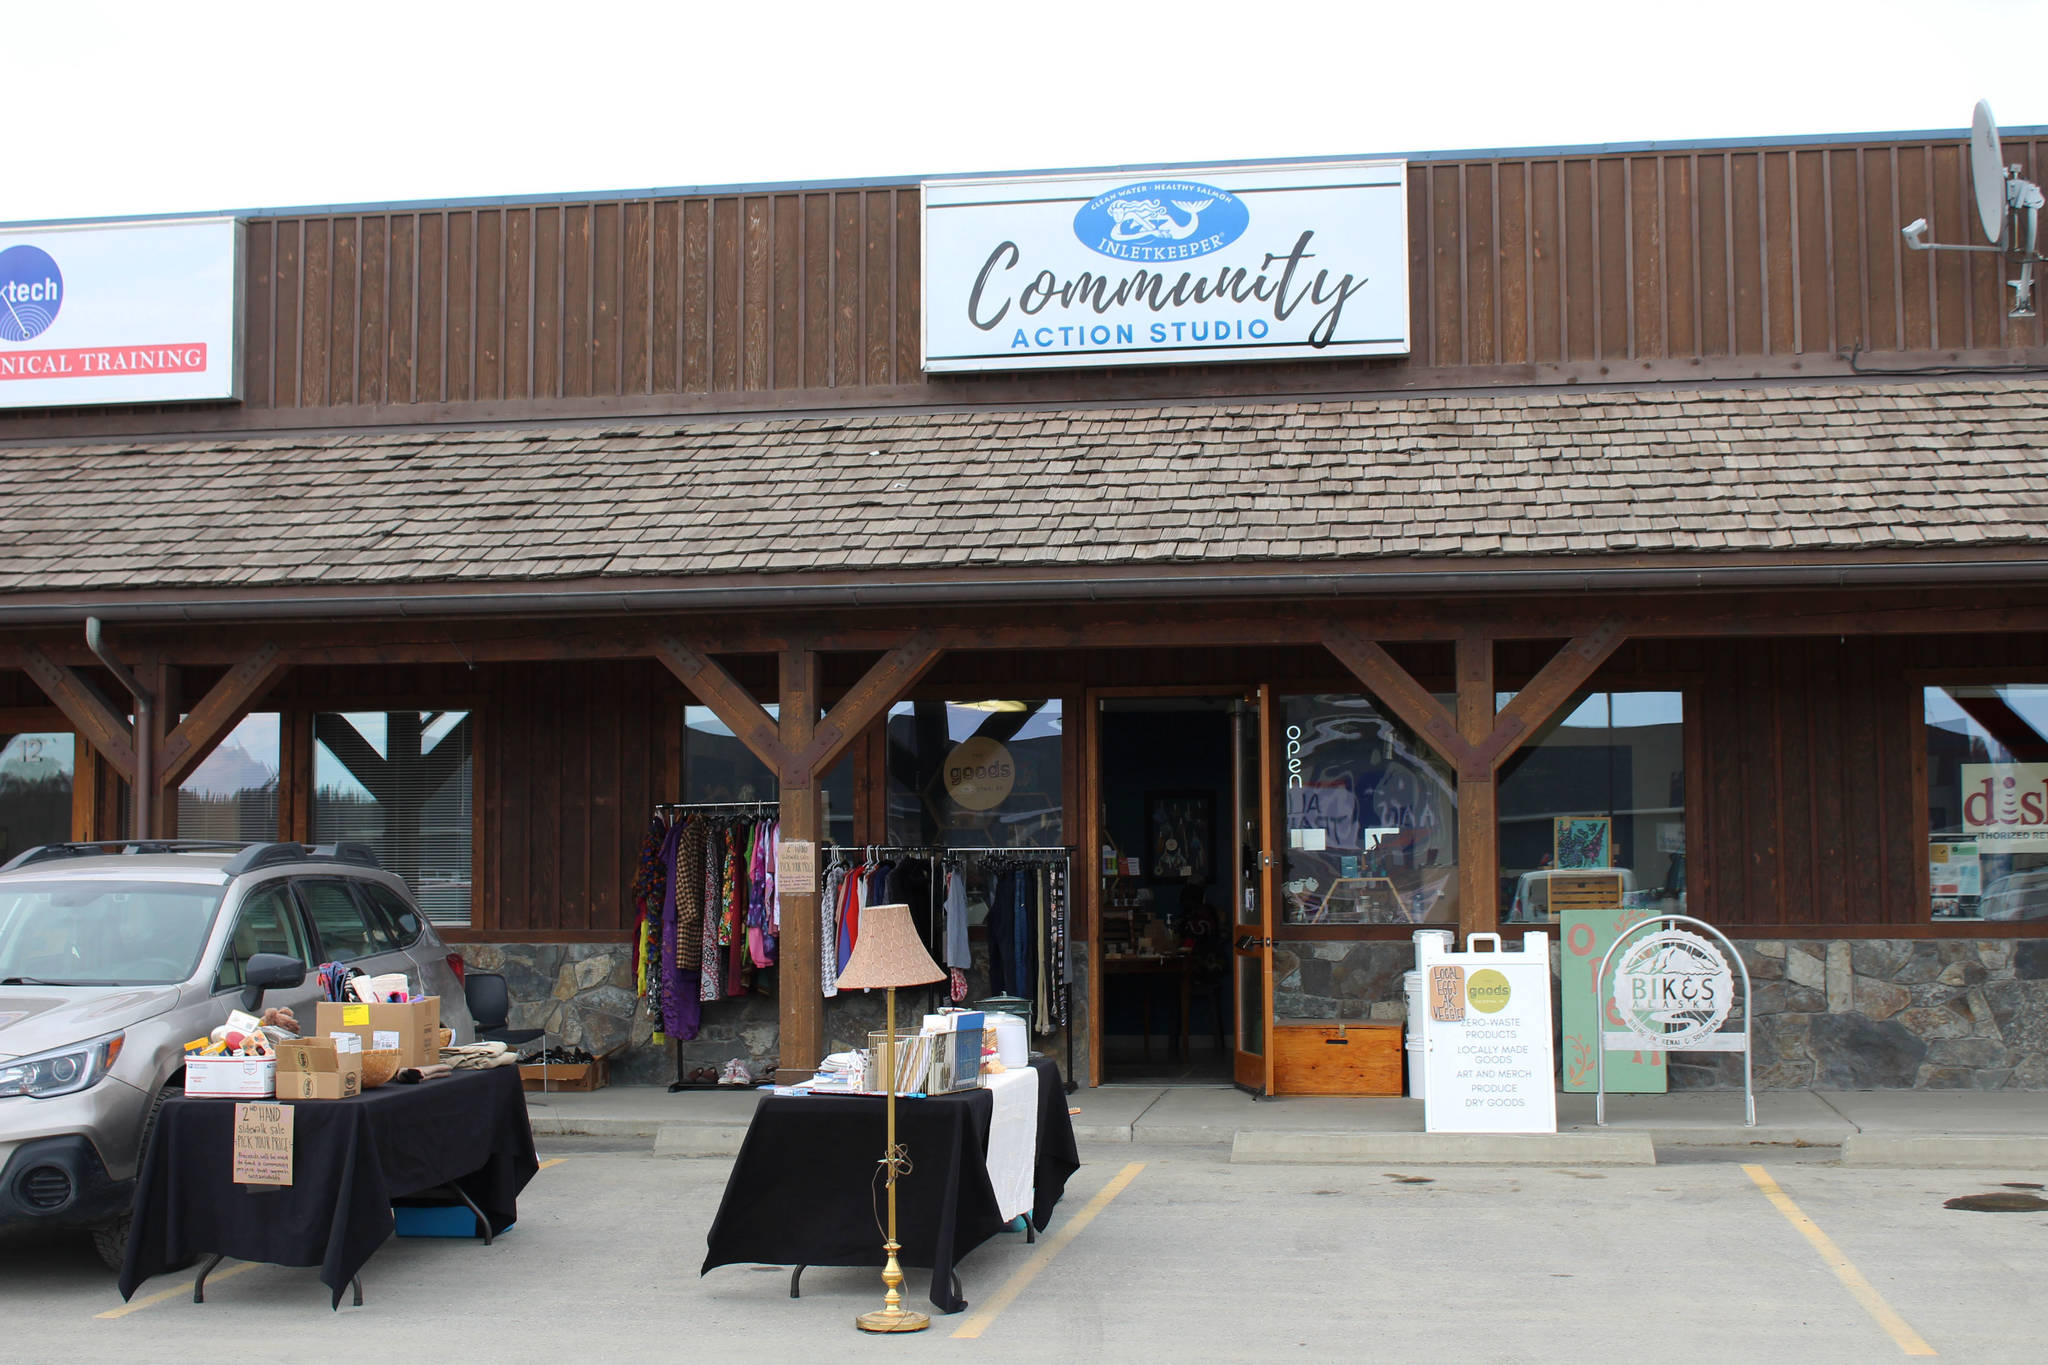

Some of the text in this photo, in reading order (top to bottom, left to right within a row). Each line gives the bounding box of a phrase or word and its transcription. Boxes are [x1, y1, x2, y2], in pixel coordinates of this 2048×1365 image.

[1091, 184, 1233, 210] CLEAN WATER HEALTHY SALMON
[1097, 234, 1224, 261] INLETKEEPER
[967, 229, 1369, 350] Community
[1011, 319, 1269, 349] ACTION STUDIO
[79, 349, 202, 371] TRAINING
[1287, 725, 1302, 789] open
[950, 760, 1012, 786] goods
[1964, 776, 2048, 827] dis
[1433, 966, 1462, 980] LOCAL
[1437, 980, 1457, 995] EGGS
[1469, 985, 1509, 999] goods
[1442, 995, 1456, 1007] AK
[1632, 1000, 1715, 1008] ALASKA
[1460, 1018, 1521, 1027] ZERO-WASTE
[1465, 1030, 1517, 1039] PRODUCTS
[1457, 1045, 1529, 1054] LOCALLY MADE
[1474, 1056, 1513, 1064] GOODS
[1456, 1069, 1532, 1078] ART AND MERCH
[1471, 1084, 1518, 1093] PRODUCE
[1465, 1098, 1526, 1107] DRY GOODS
[259, 1106, 281, 1122] HAND
